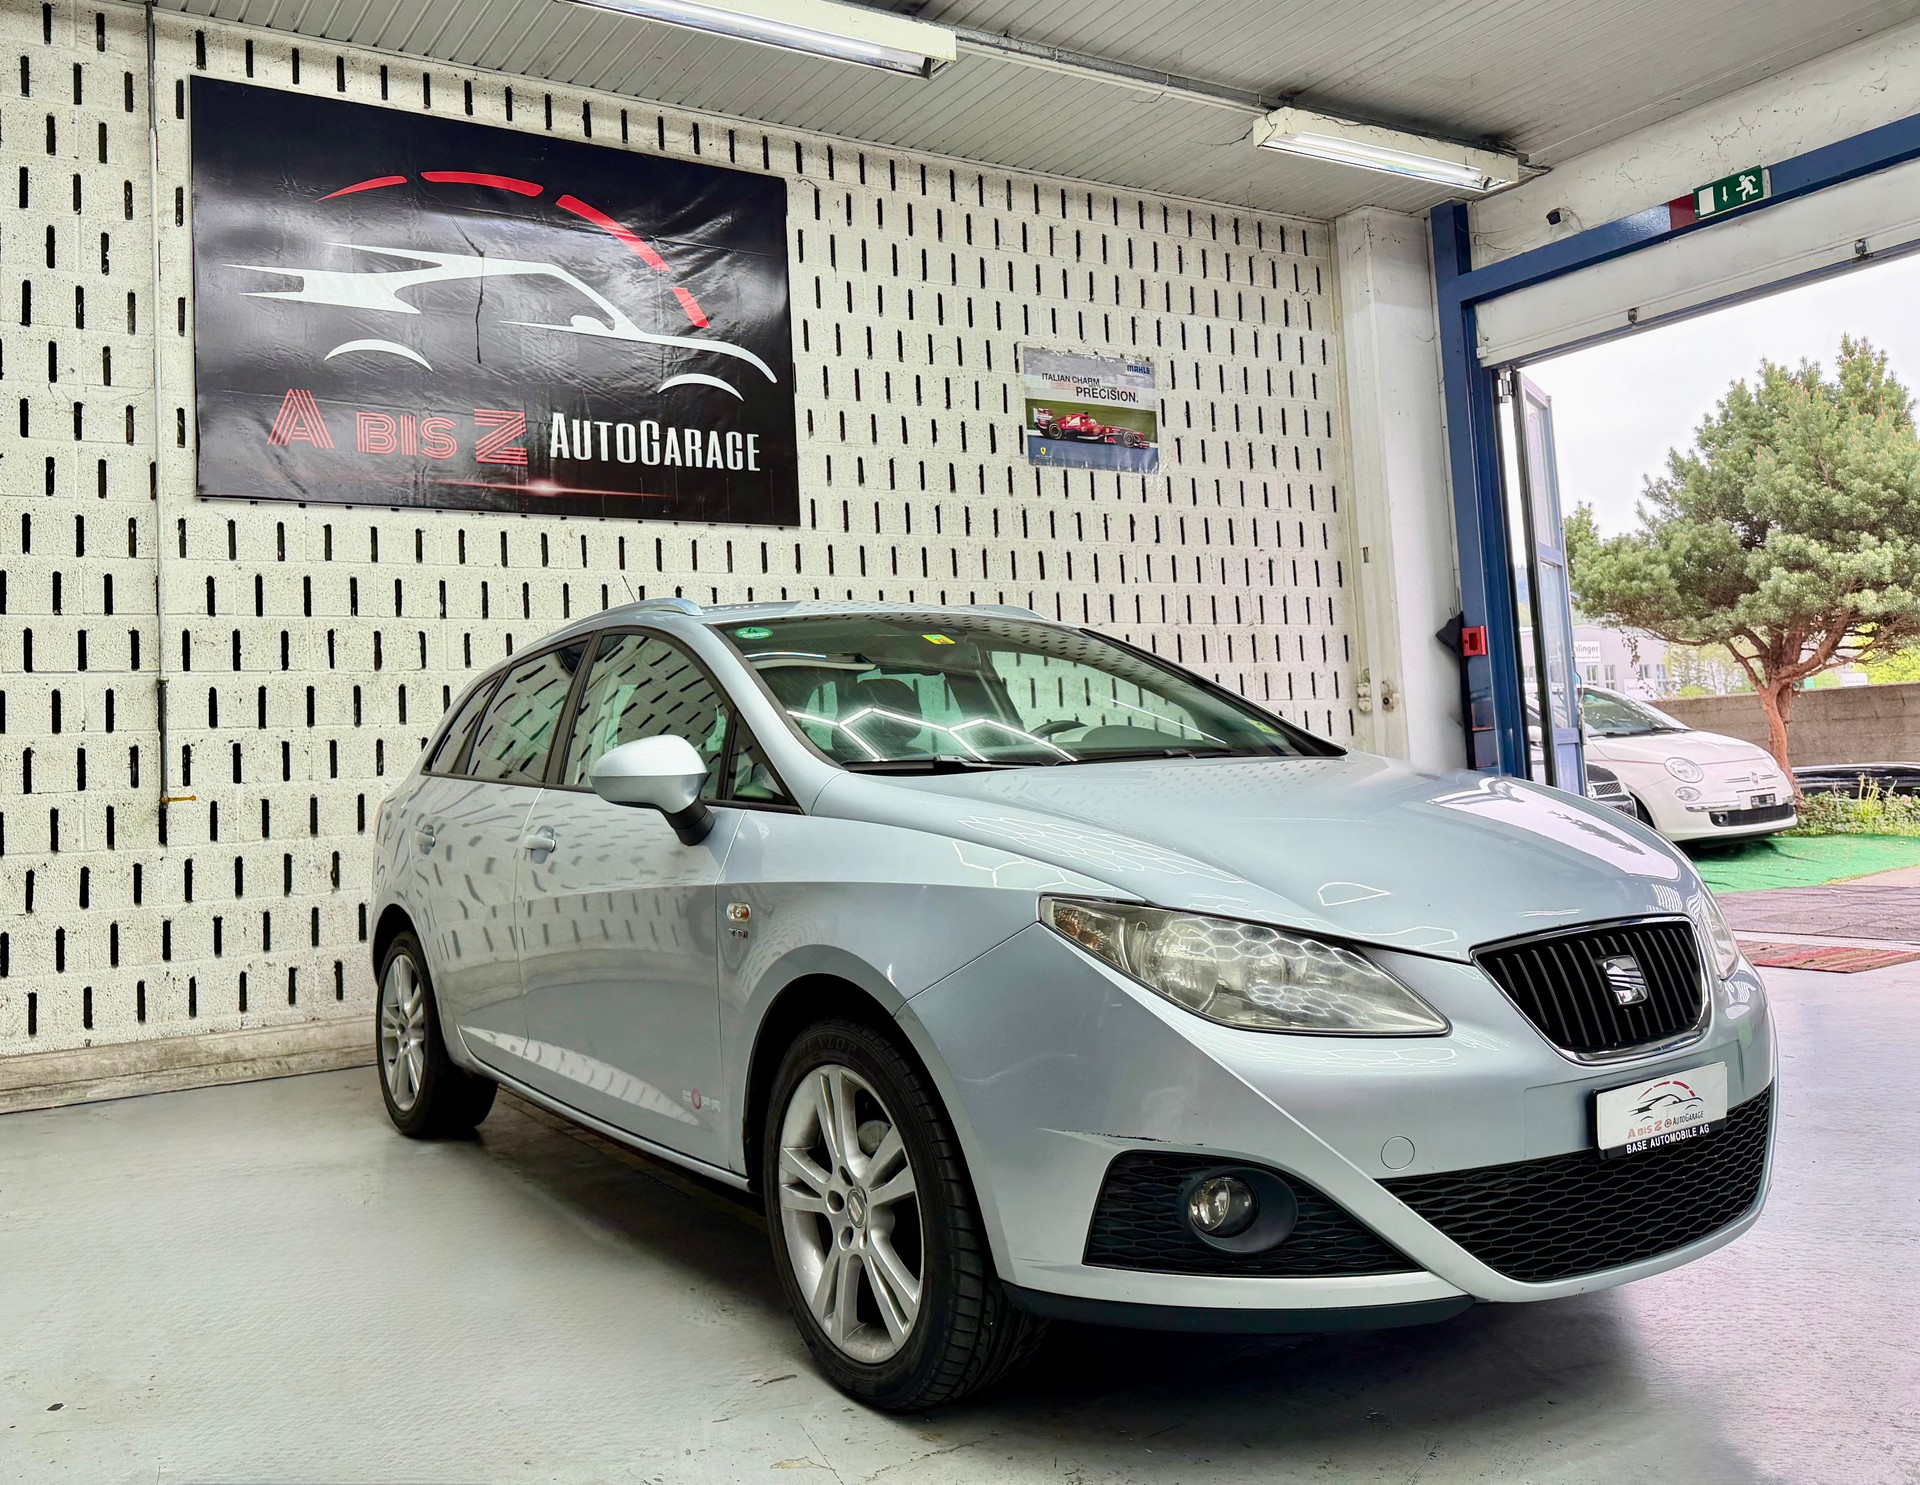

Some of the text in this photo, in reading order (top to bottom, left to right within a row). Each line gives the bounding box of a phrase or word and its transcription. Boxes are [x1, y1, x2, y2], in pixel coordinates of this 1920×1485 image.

[1127, 364, 1150, 375] MAHLE
[1042, 373, 1100, 386] ITALIAN CHARM
[1076, 387, 1139, 403] PRECISION.
[267, 388, 334, 449] A
[356, 412, 458, 459] BIS
[474, 408, 528, 465] Z
[1626, 1124, 1710, 1154] BASE AUTOMOBILE AG
[1628, 1128, 1636, 1139] A
